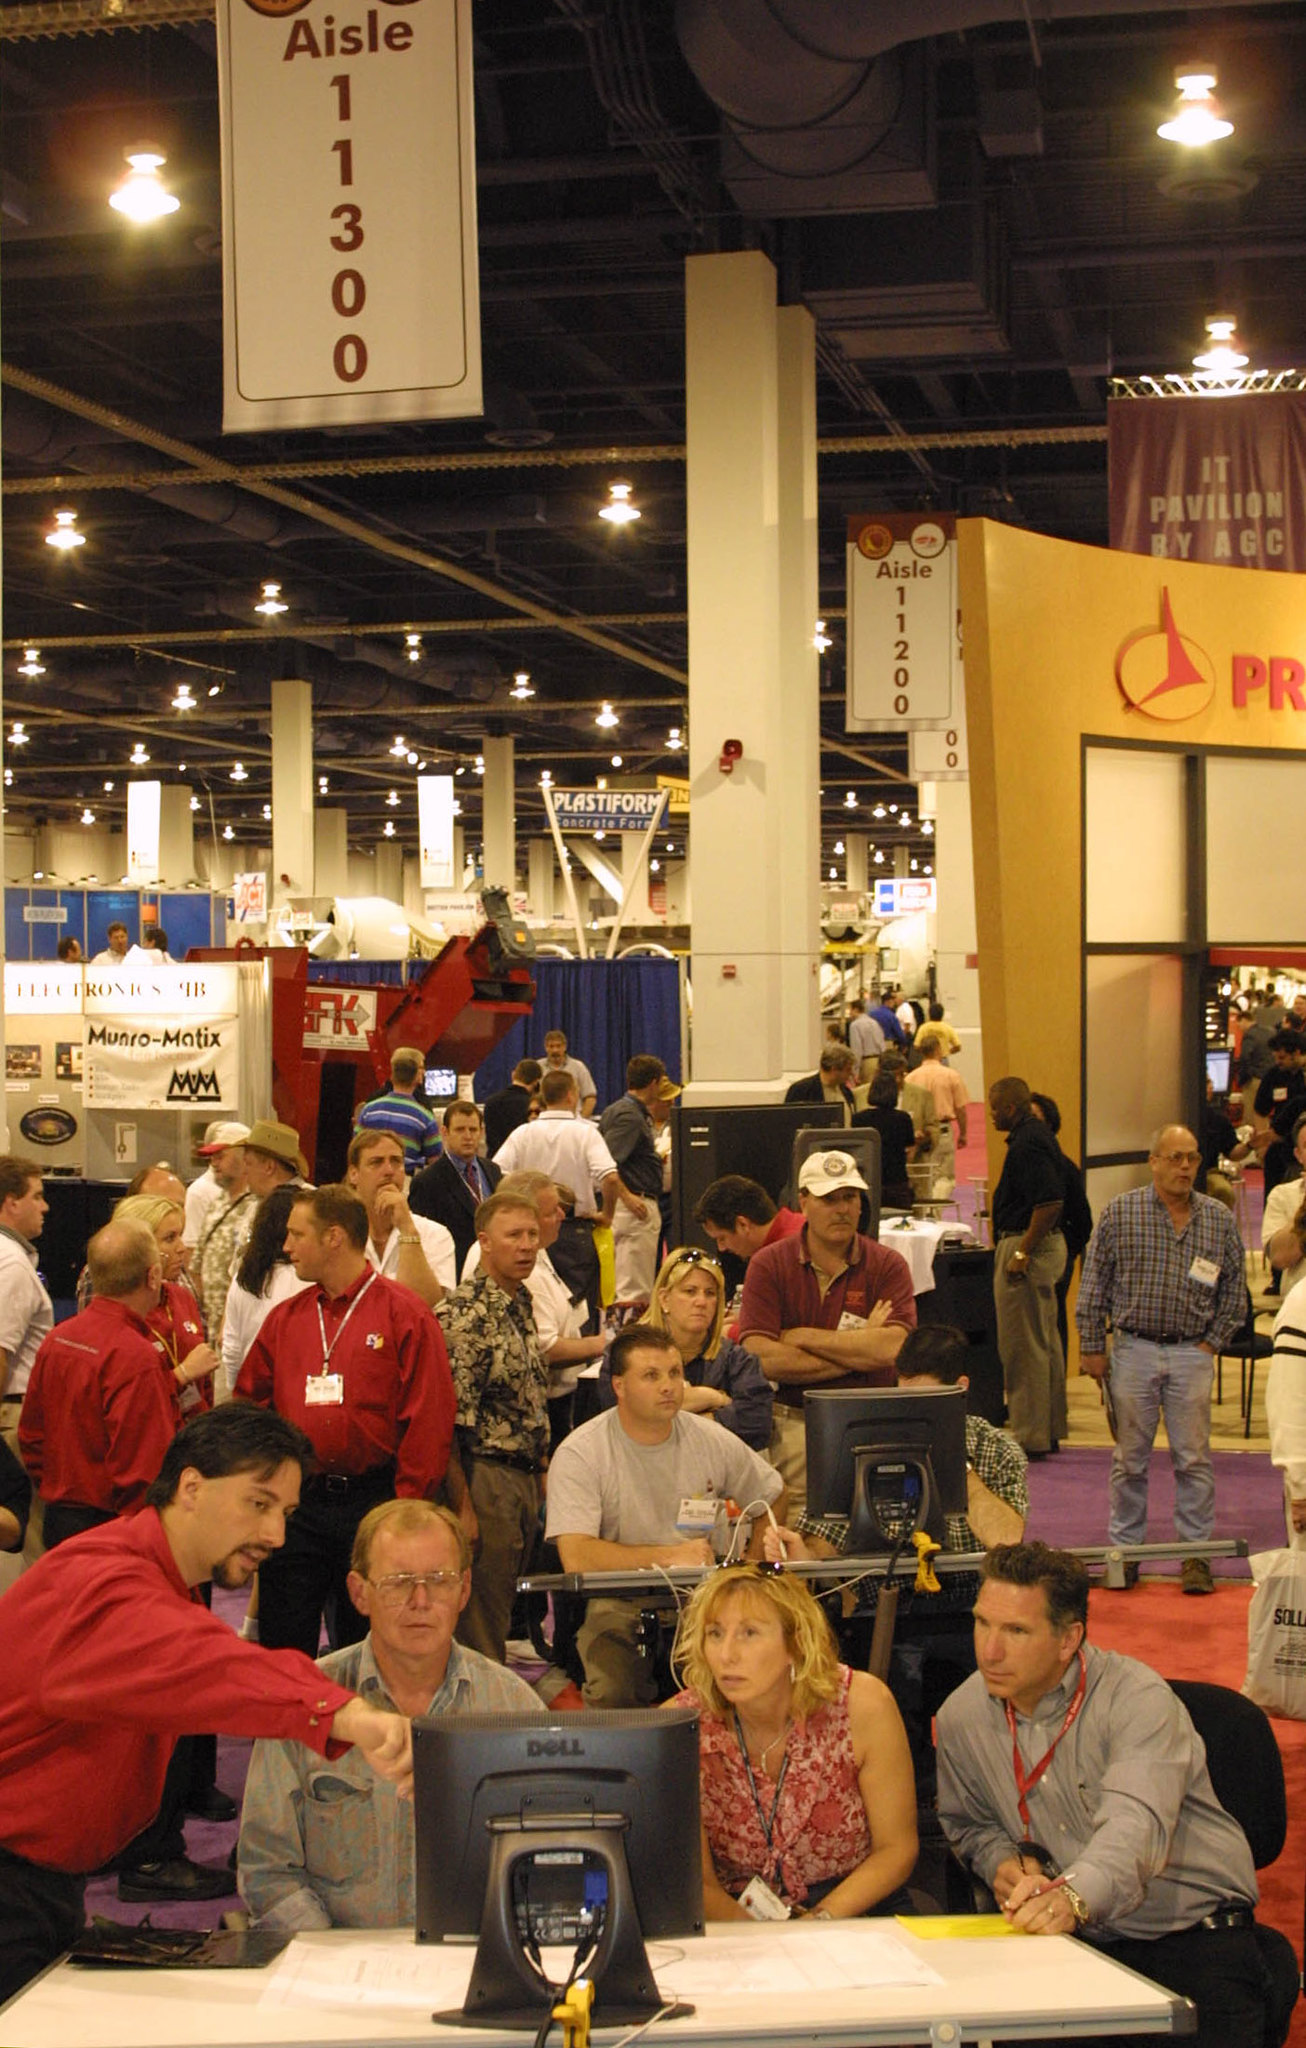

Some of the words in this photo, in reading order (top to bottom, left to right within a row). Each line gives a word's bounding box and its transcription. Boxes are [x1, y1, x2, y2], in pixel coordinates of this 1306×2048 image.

[282, 9, 414, 62] Aisle
[1202, 456, 1230, 483] IT
[1151, 491, 1283, 523] PAVILION
[1151, 532, 1193, 559] BY
[1214, 528, 1284, 558] AGC
[875, 560, 932, 579] Aisle
[553, 792, 664, 813] PLASTIFORM
[88, 1026, 221, 1049] Munro-Matix
[527, 1739, 584, 1757] DELL
